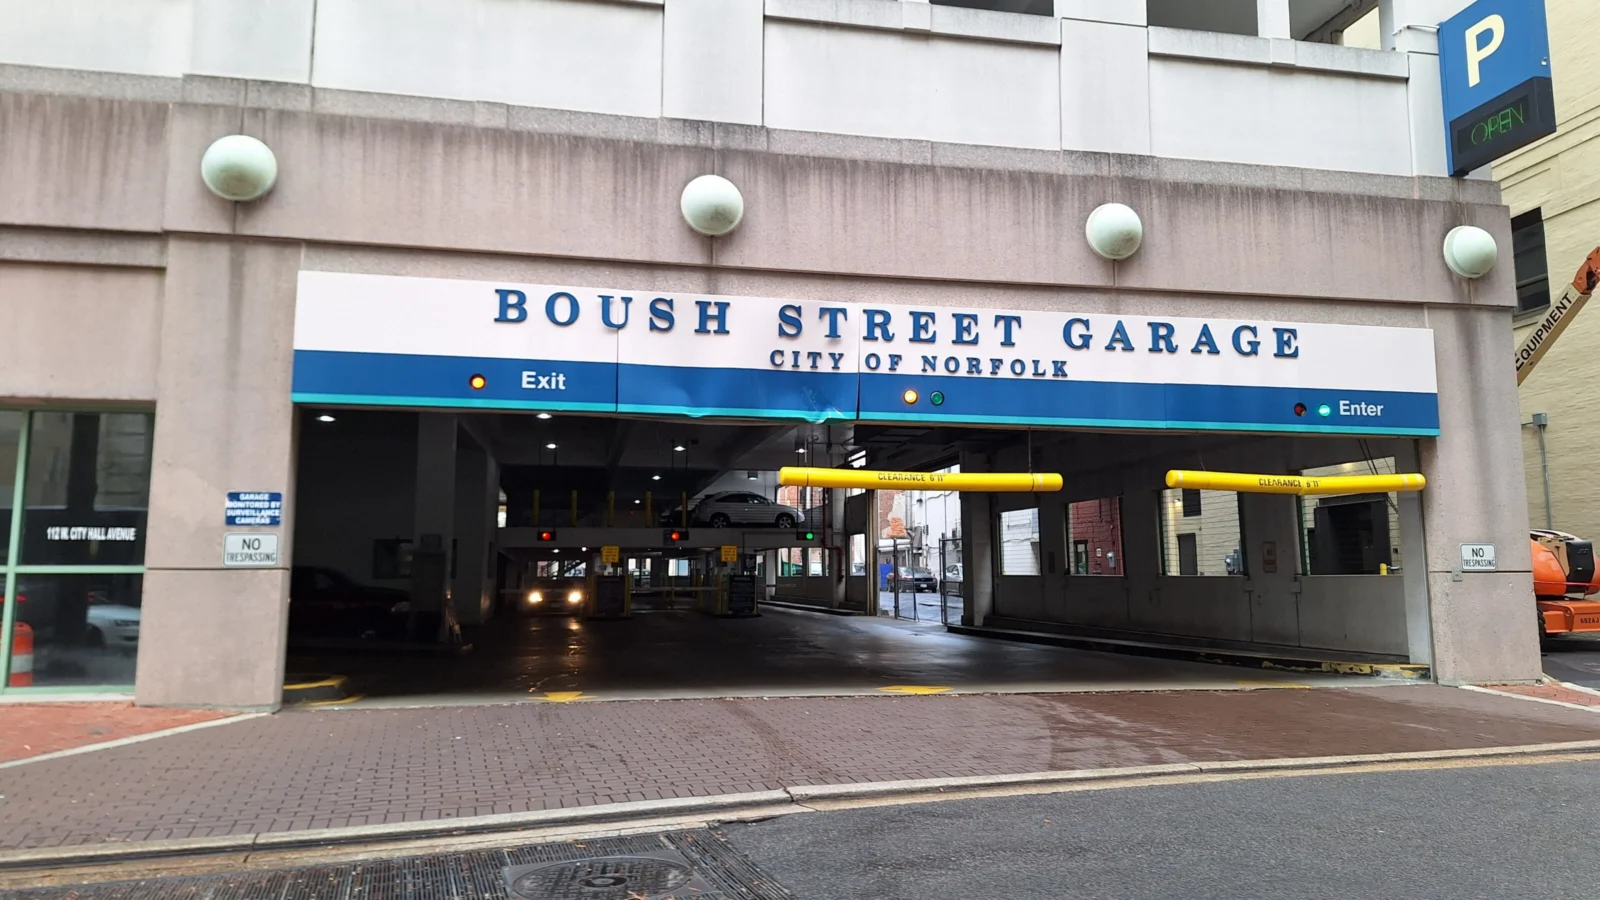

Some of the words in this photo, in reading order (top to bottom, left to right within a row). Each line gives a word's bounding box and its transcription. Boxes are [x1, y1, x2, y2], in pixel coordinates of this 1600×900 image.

[1465, 14, 1505, 88] P
[1471, 102, 1525, 145] OPEN
[494, 287, 730, 335] BOUSH
[778, 304, 1022, 347] STREET
[1062, 318, 1300, 359] GARAGE
[1515, 292, 1573, 372] EQUIPMENT
[770, 349, 846, 371] CITY
[865, 353, 903, 373] OF
[921, 355, 1069, 378] NORFOLK
[522, 370, 566, 390] Exit
[1339, 400, 1384, 416] Enter
[877, 472, 926, 482] CLEARANCE
[1258, 478, 1302, 487] CLEARANCE
[226, 508, 280, 517] SURVEILLANCE
[46, 526, 60, 541] 112
[70, 526, 88, 541] CITY
[87, 527, 106, 541] HALL
[106, 527, 137, 541] AVENUE
[241, 538, 261, 550] NO
[226, 552, 276, 562] TRESPASSING
[1471, 547, 1485, 558] NO
[1463, 559, 1495, 567] TRESPASSING
